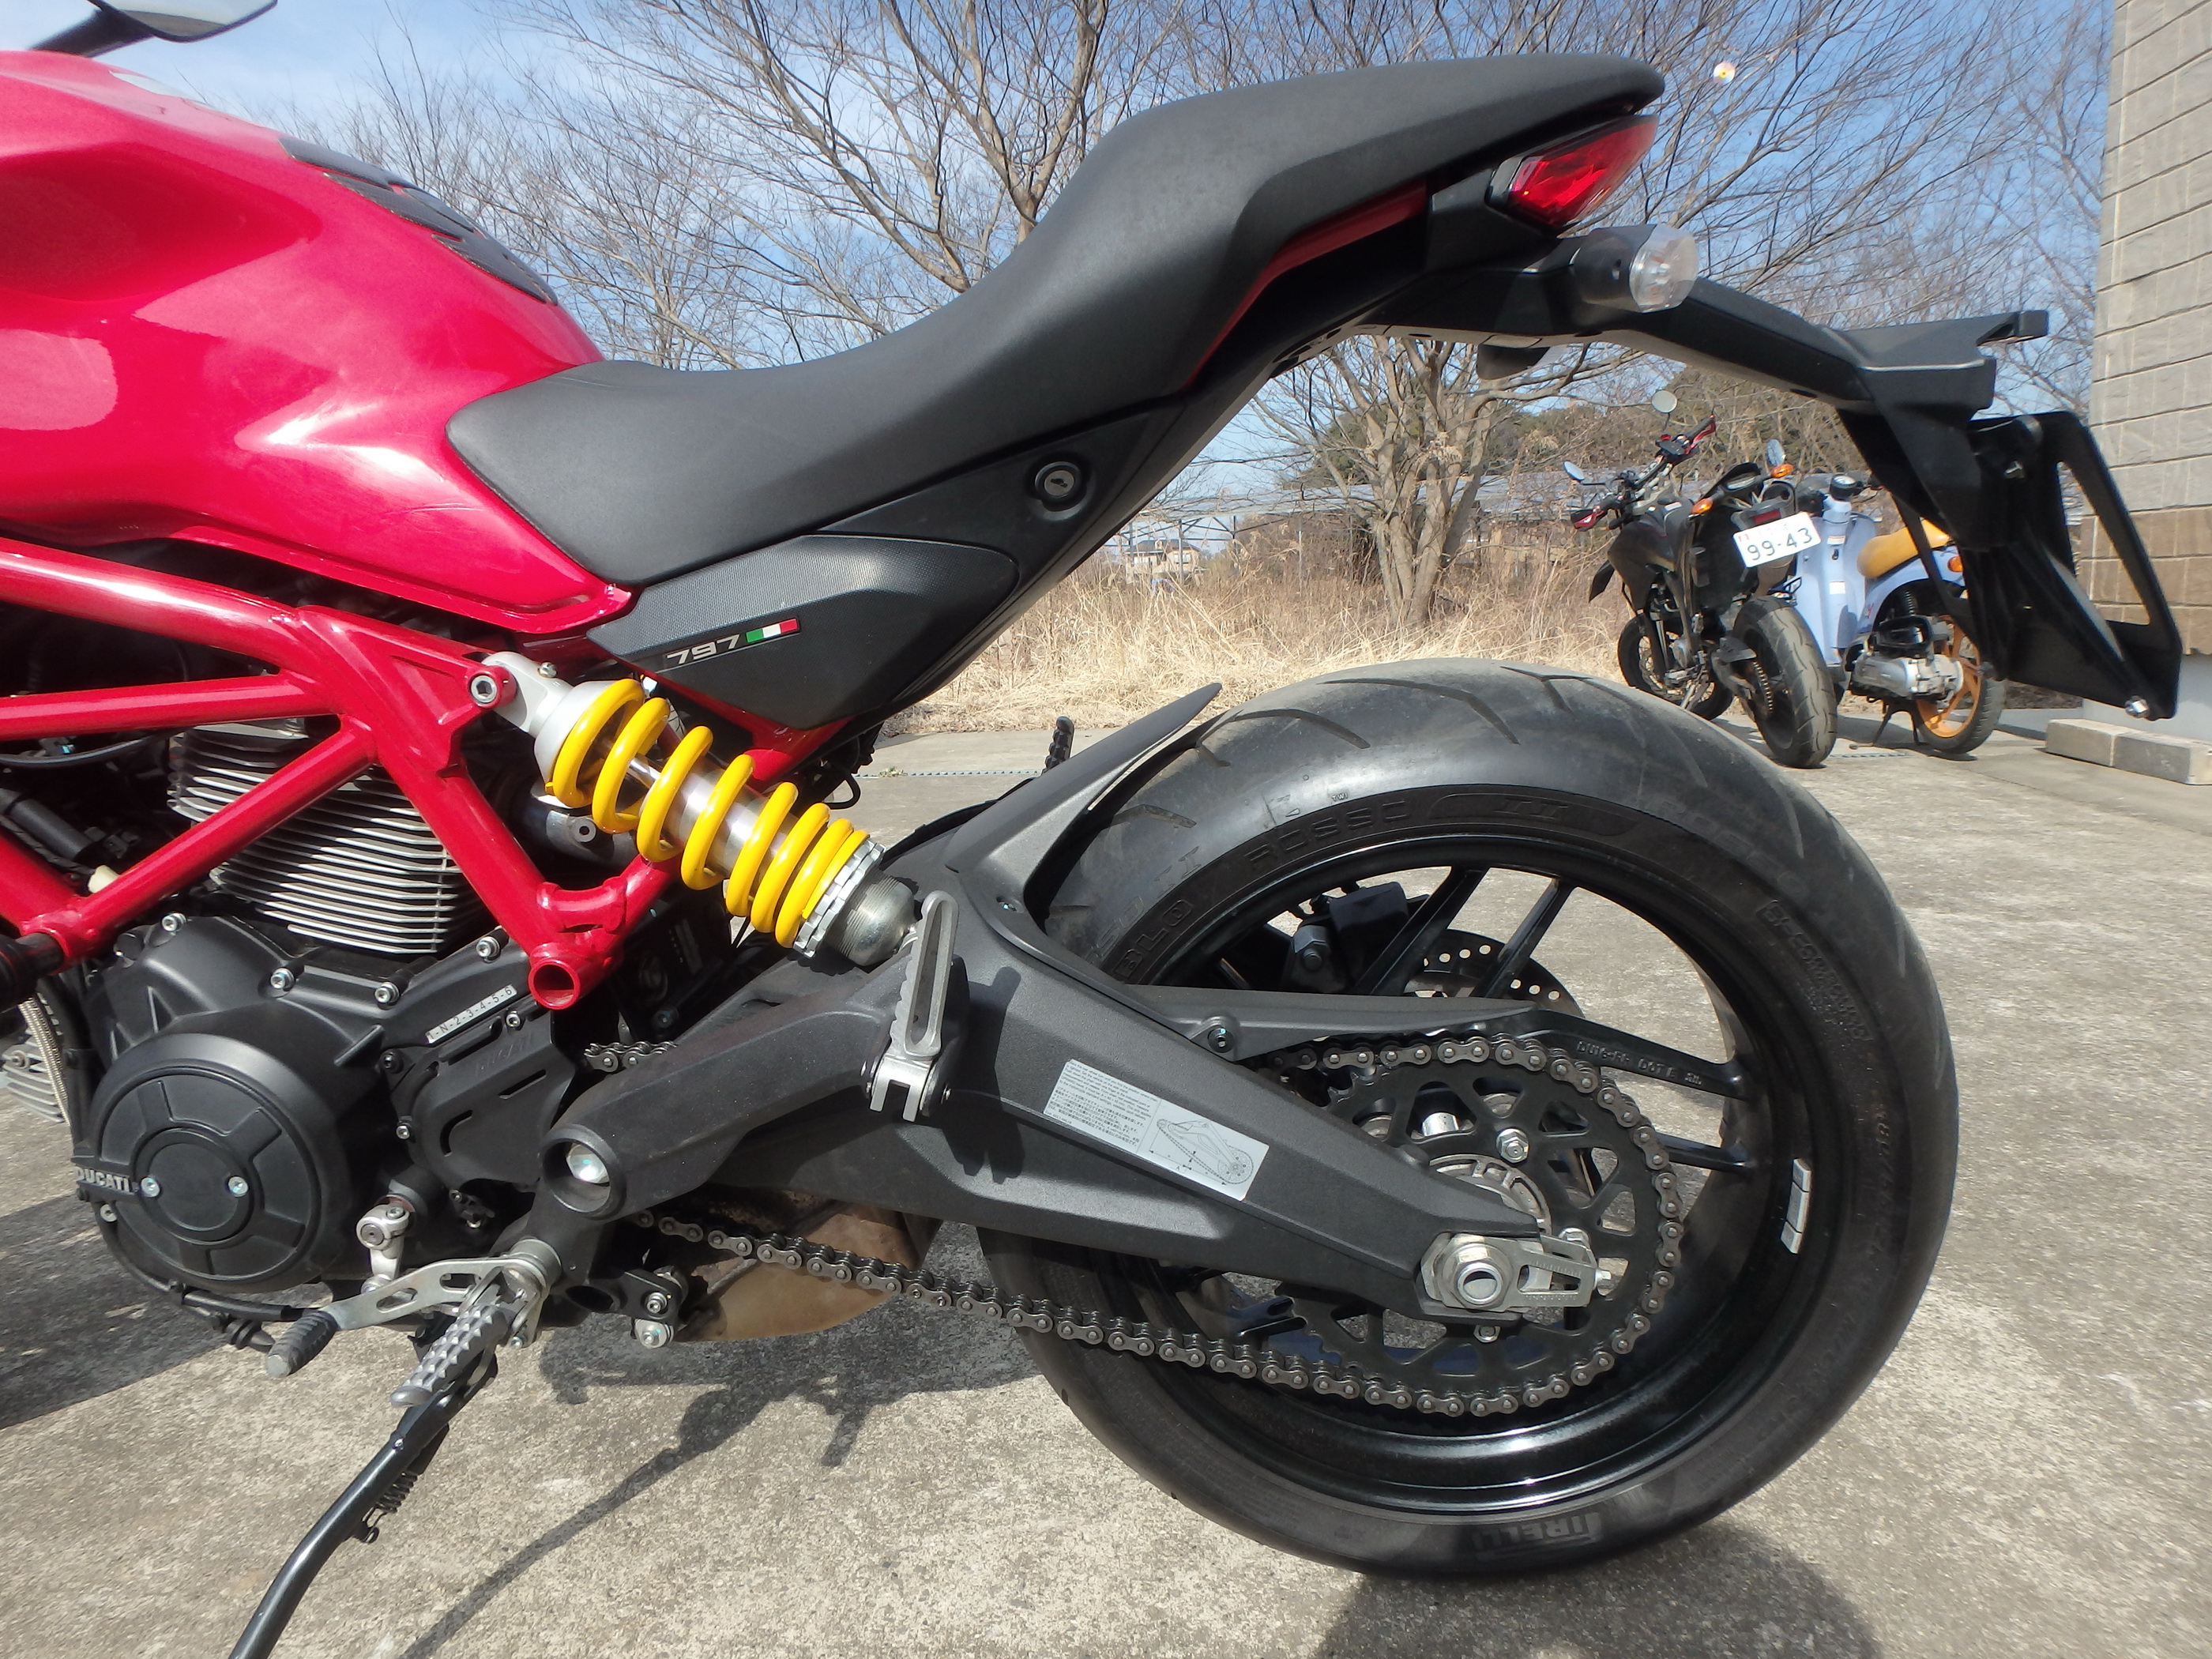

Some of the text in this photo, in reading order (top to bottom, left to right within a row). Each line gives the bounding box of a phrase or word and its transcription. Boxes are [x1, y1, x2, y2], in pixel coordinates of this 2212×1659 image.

[1747, 527, 1813, 562] 99-43
[666, 633, 740, 665] 797
[1330, 792, 1349, 803] TWI
[73, 1166, 130, 1192] DUCATI
